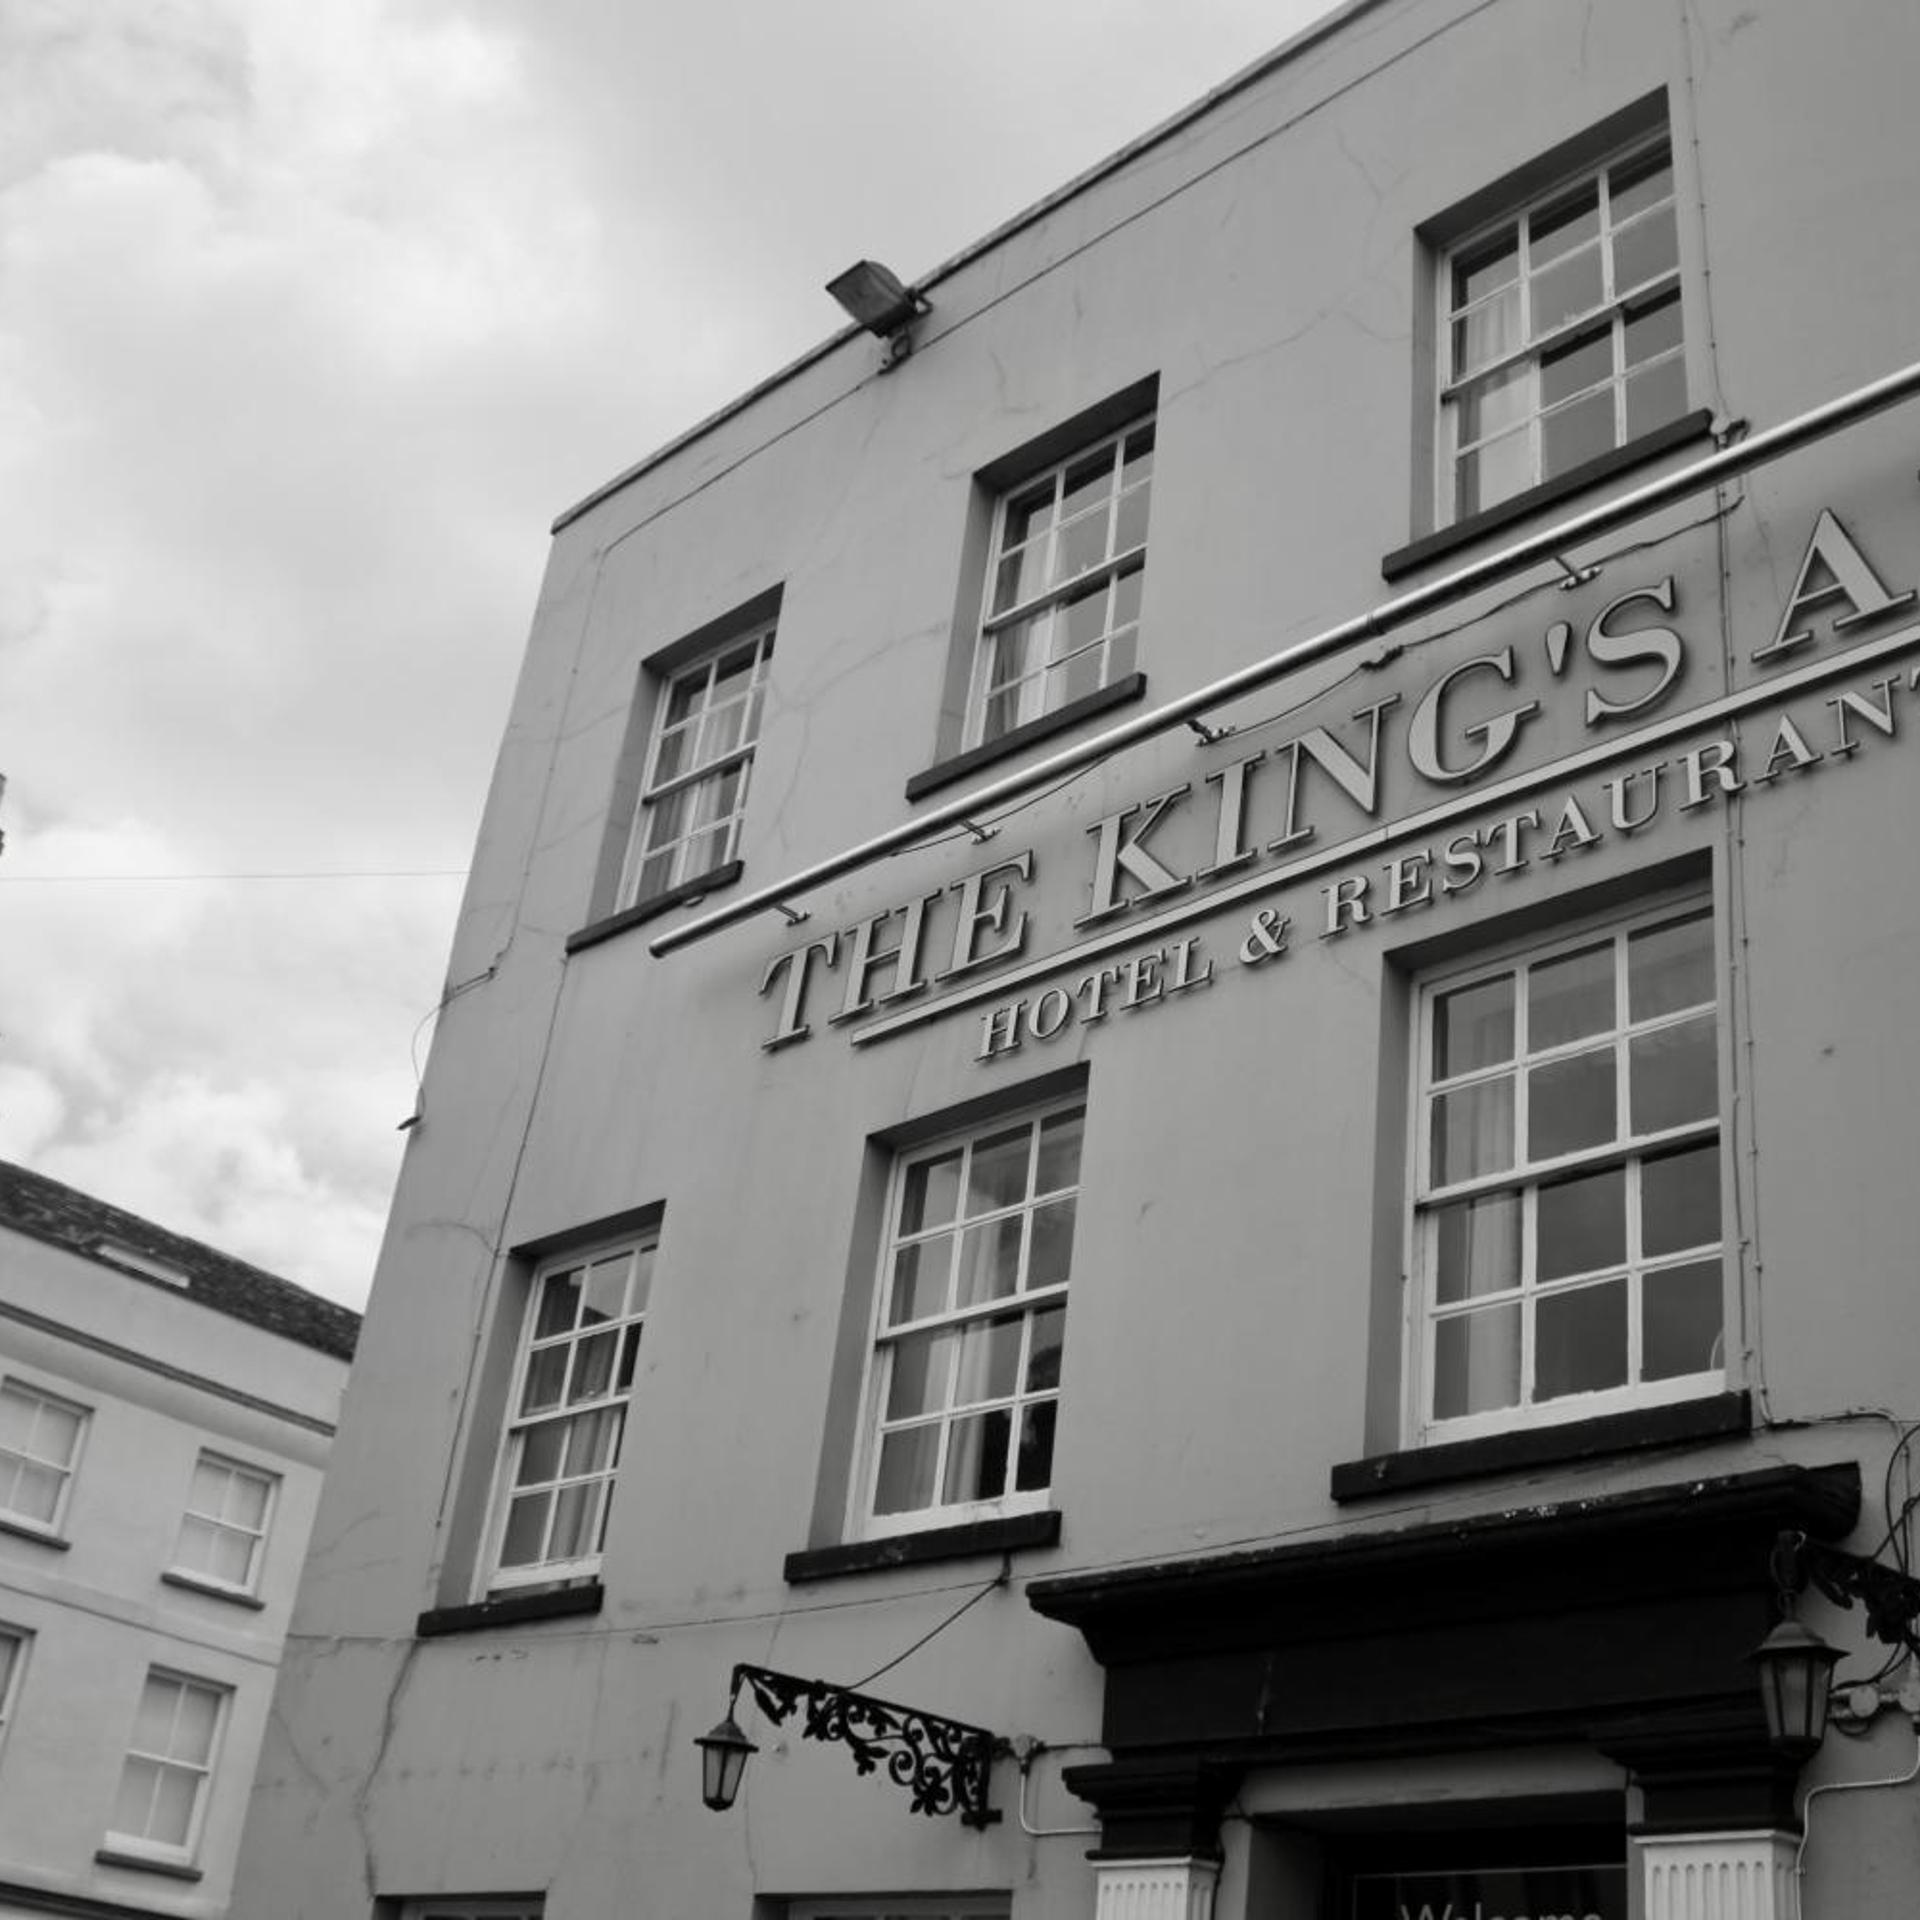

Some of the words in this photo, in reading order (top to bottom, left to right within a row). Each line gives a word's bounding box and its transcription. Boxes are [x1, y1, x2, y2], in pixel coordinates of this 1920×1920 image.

[759, 850, 1033, 1050] THE
[1074, 575, 1683, 928] KING'S
[1752, 507, 1920, 662] A
[974, 938, 1212, 1063] HOTEL
[1239, 909, 1289, 964] &
[1319, 666, 1920, 940] RESTAURAN
